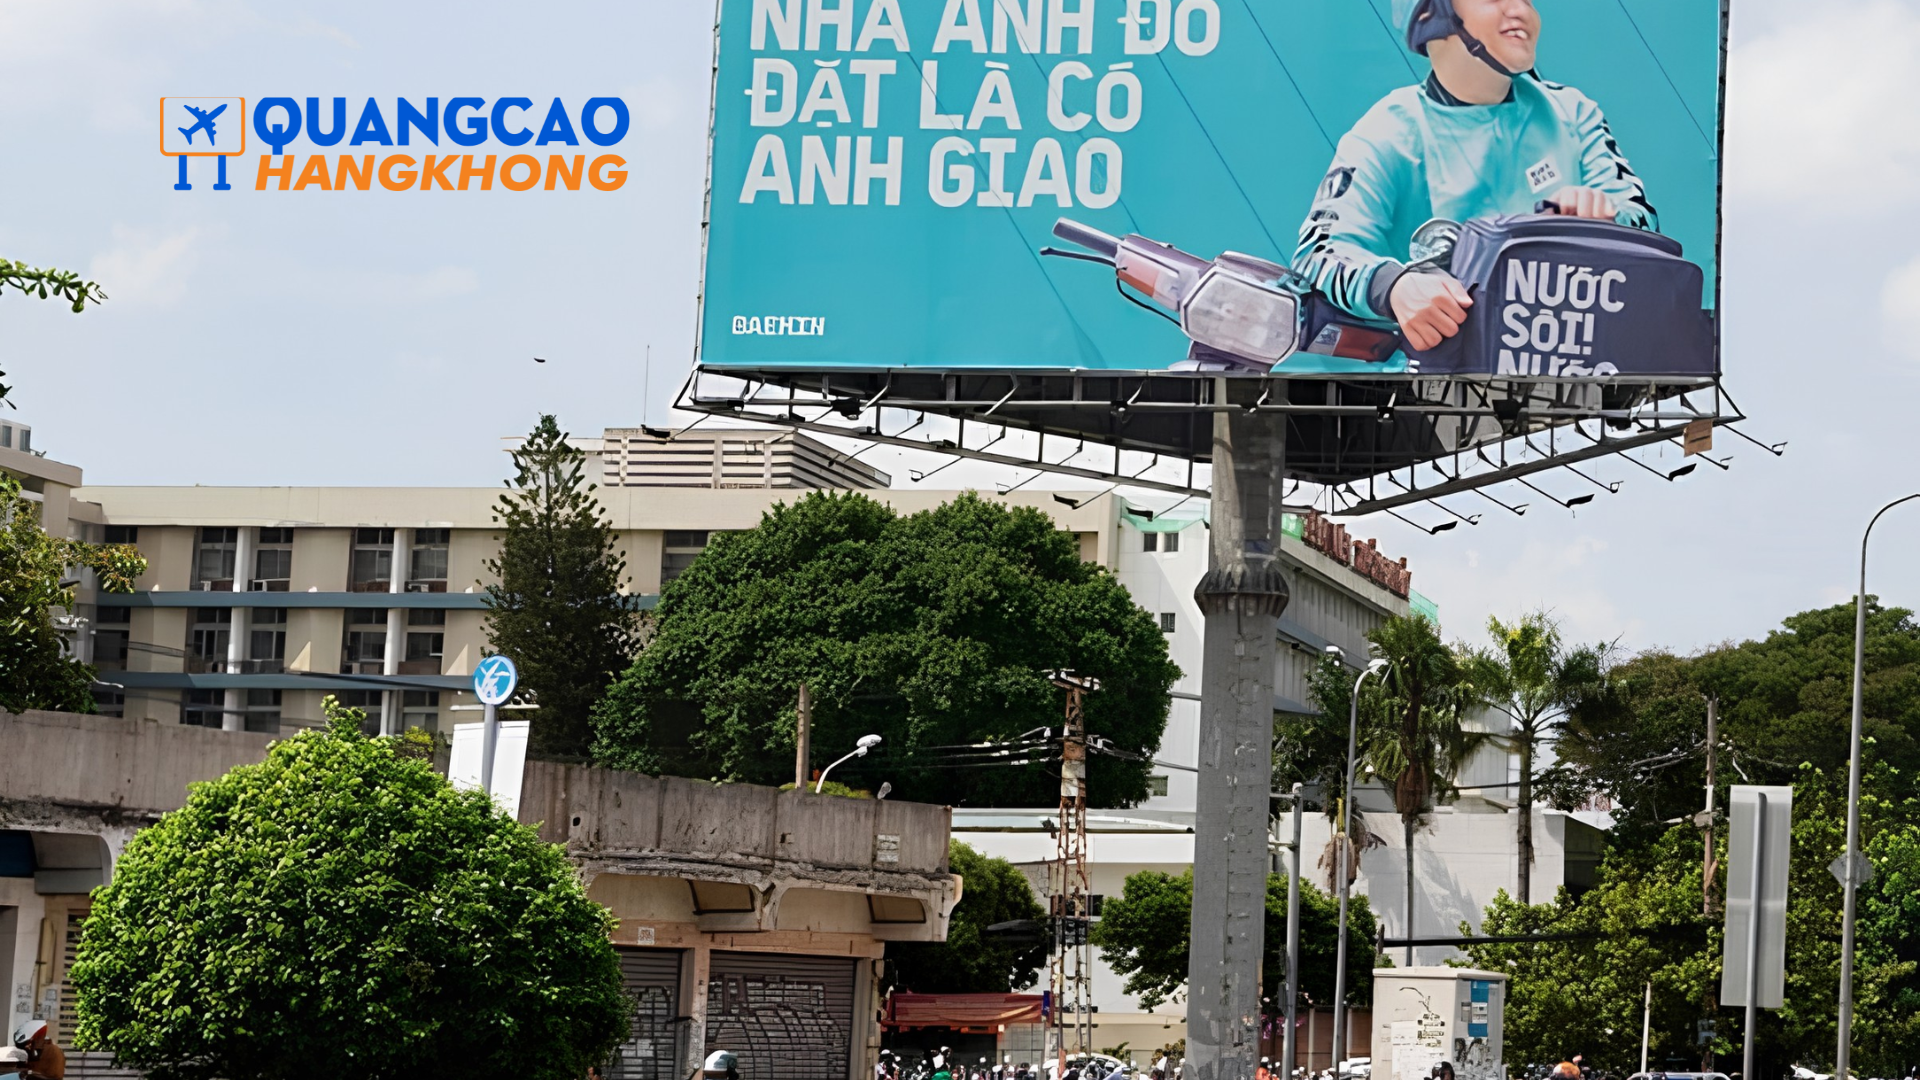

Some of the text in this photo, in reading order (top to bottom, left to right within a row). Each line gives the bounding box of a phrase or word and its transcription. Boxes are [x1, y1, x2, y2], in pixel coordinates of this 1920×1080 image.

[932, 0, 1093, 54] ANH
[744, 57, 1143, 132] ĐẶT LÀ CÓ
[738, 134, 1123, 208] ANH GIAO
[1505, 258, 1627, 312] NƯỚC
